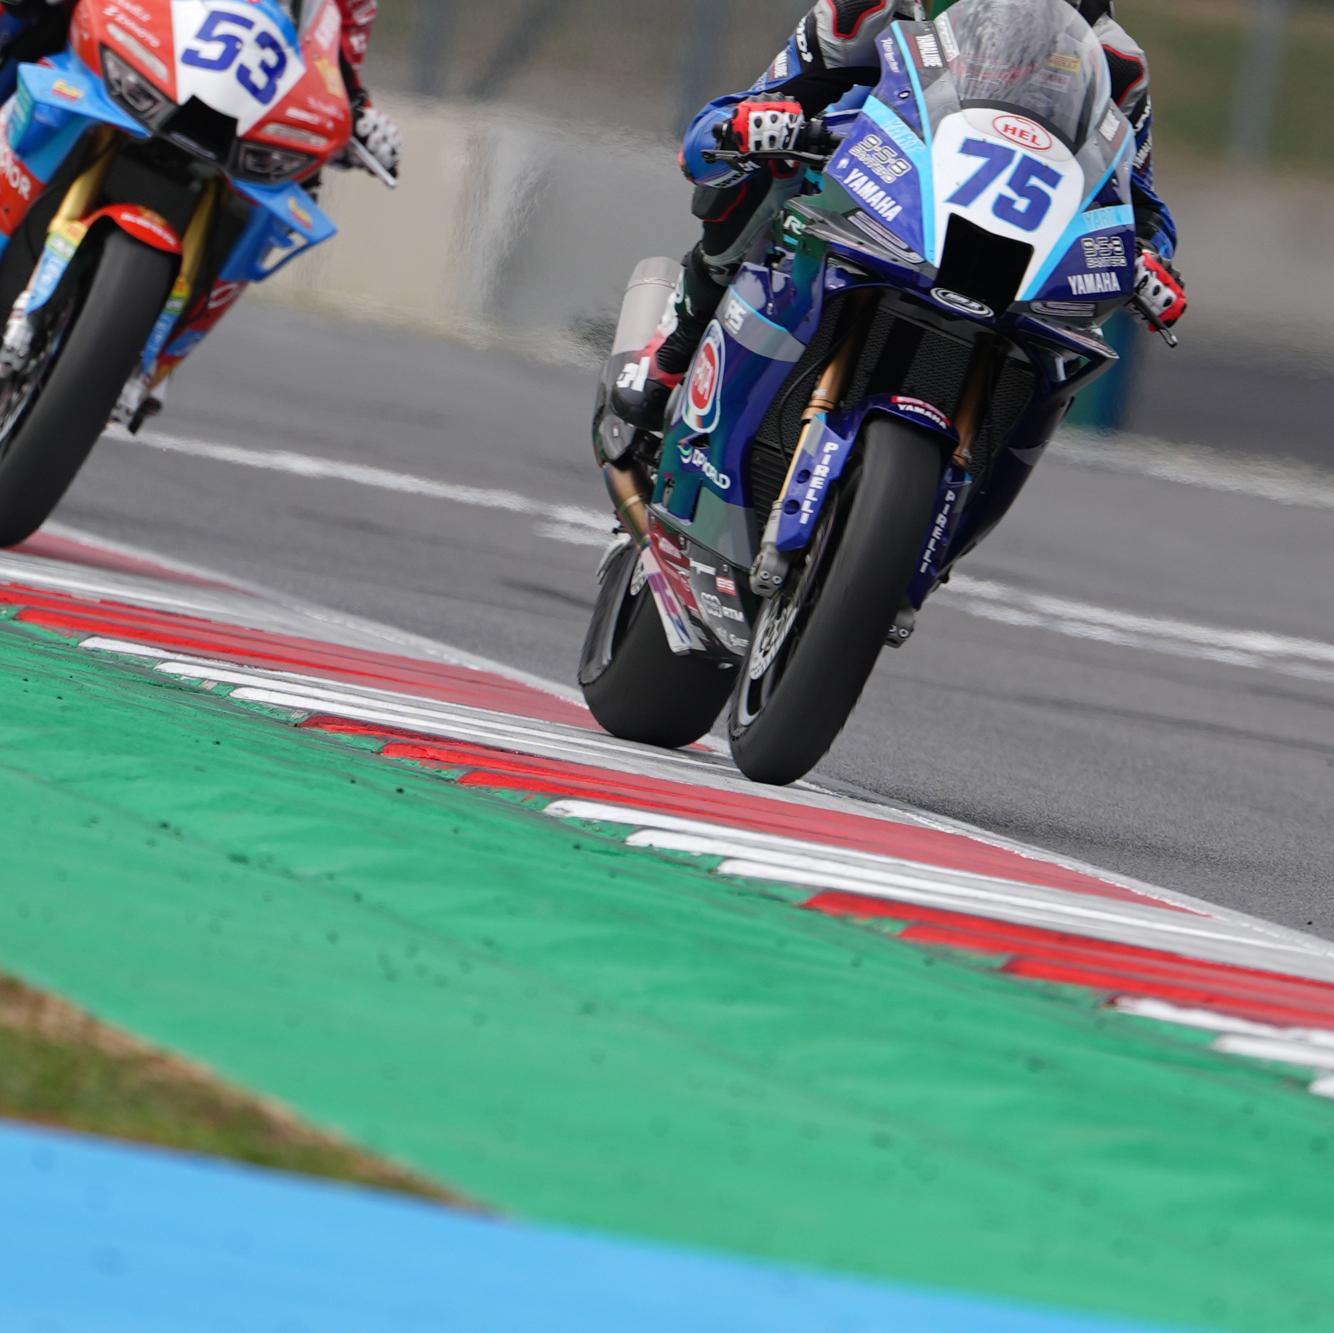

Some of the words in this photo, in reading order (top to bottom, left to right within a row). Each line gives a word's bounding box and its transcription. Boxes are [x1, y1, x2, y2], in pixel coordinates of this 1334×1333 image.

[180, 10, 288, 106] 53
[915, 33, 943, 67] YAMALUBE
[1003, 124, 1042, 146] HEL
[843, 168, 903, 222] YAMAHA
[944, 137, 1064, 233] 75
[1067, 271, 1121, 296] YAMAHA
[898, 403, 948, 430] YAMAHA
[800, 442, 840, 525] PIRELLI
[920, 490, 956, 574] PIRELLI
